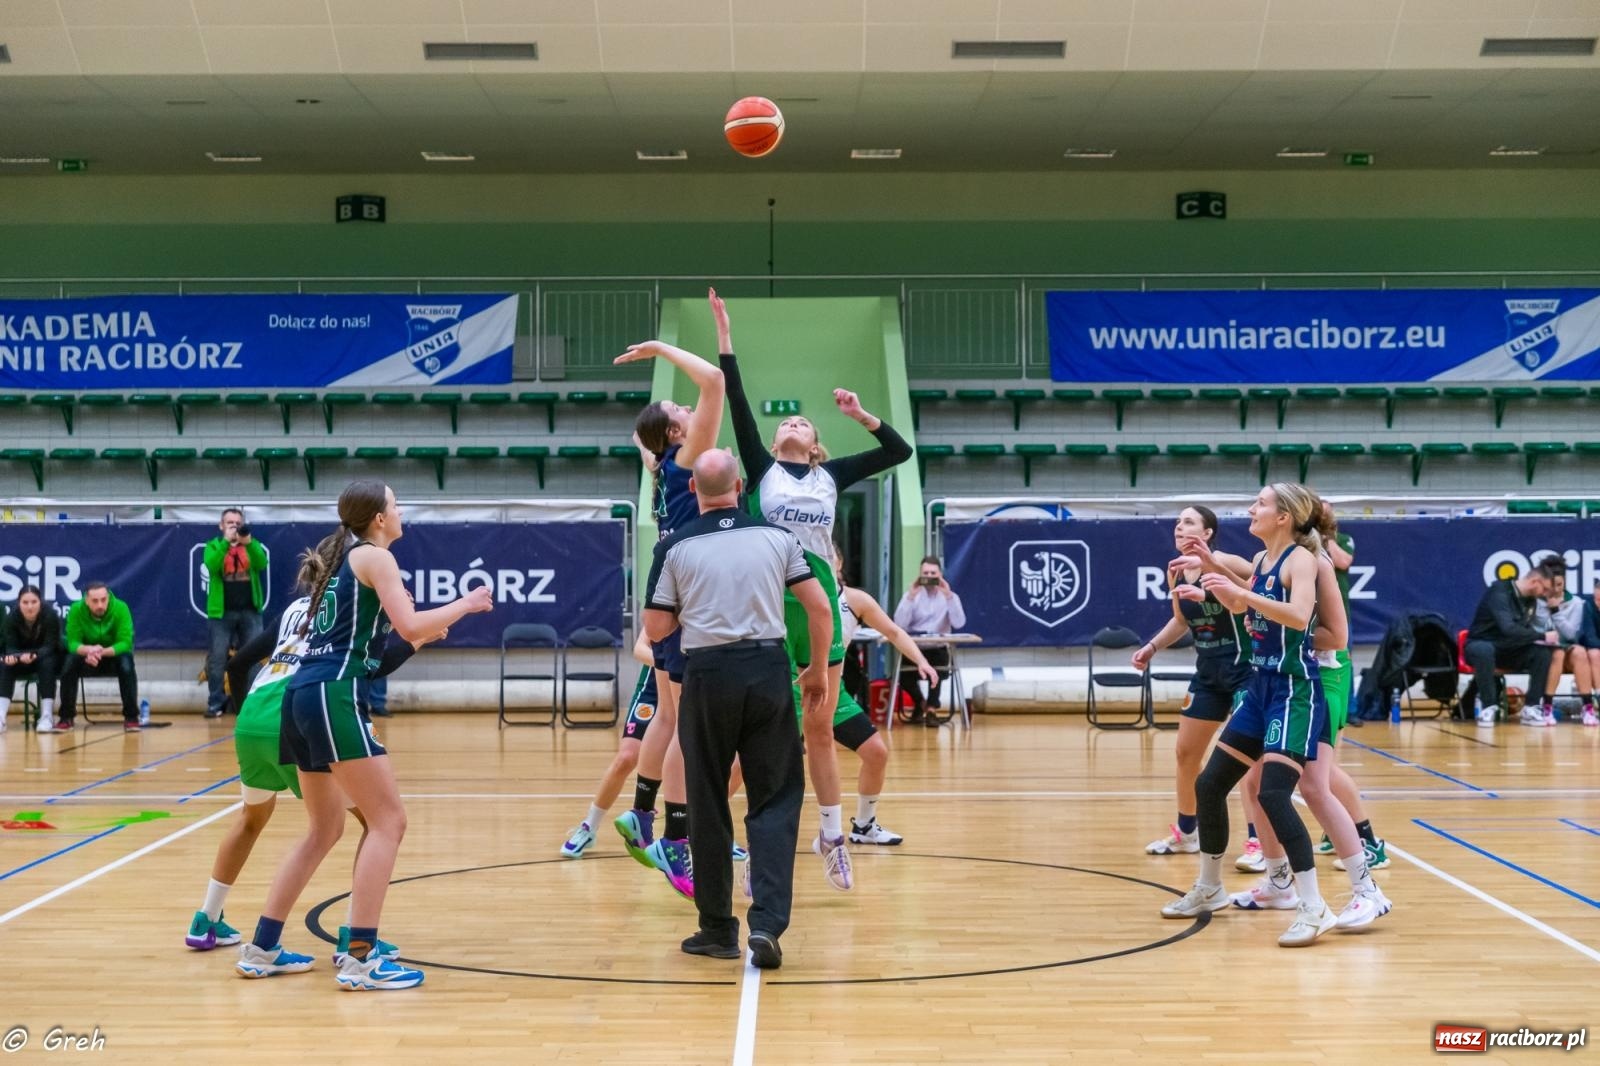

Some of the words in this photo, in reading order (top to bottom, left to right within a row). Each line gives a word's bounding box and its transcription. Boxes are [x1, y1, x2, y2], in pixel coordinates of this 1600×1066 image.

[340, 204, 352, 219] B
[362, 203, 379, 219] B
[1181, 200, 1199, 216] C
[1209, 200, 1223, 216] C
[411, 306, 457, 316] RACIBÓRZ
[0, 311, 156, 341] KADEMIA
[268, 314, 316, 331] Dołącz
[320, 314, 338, 329] do
[342, 313, 371, 329] nas!
[1088, 319, 1446, 350] www.uniaraciborz.eu
[1510, 325, 1553, 352] UNIA
[0, 345, 45, 372] NII
[60, 336, 243, 372] RACIBÓRZ
[411, 331, 455, 359] UNIA
[783, 508, 832, 526] Clavis
